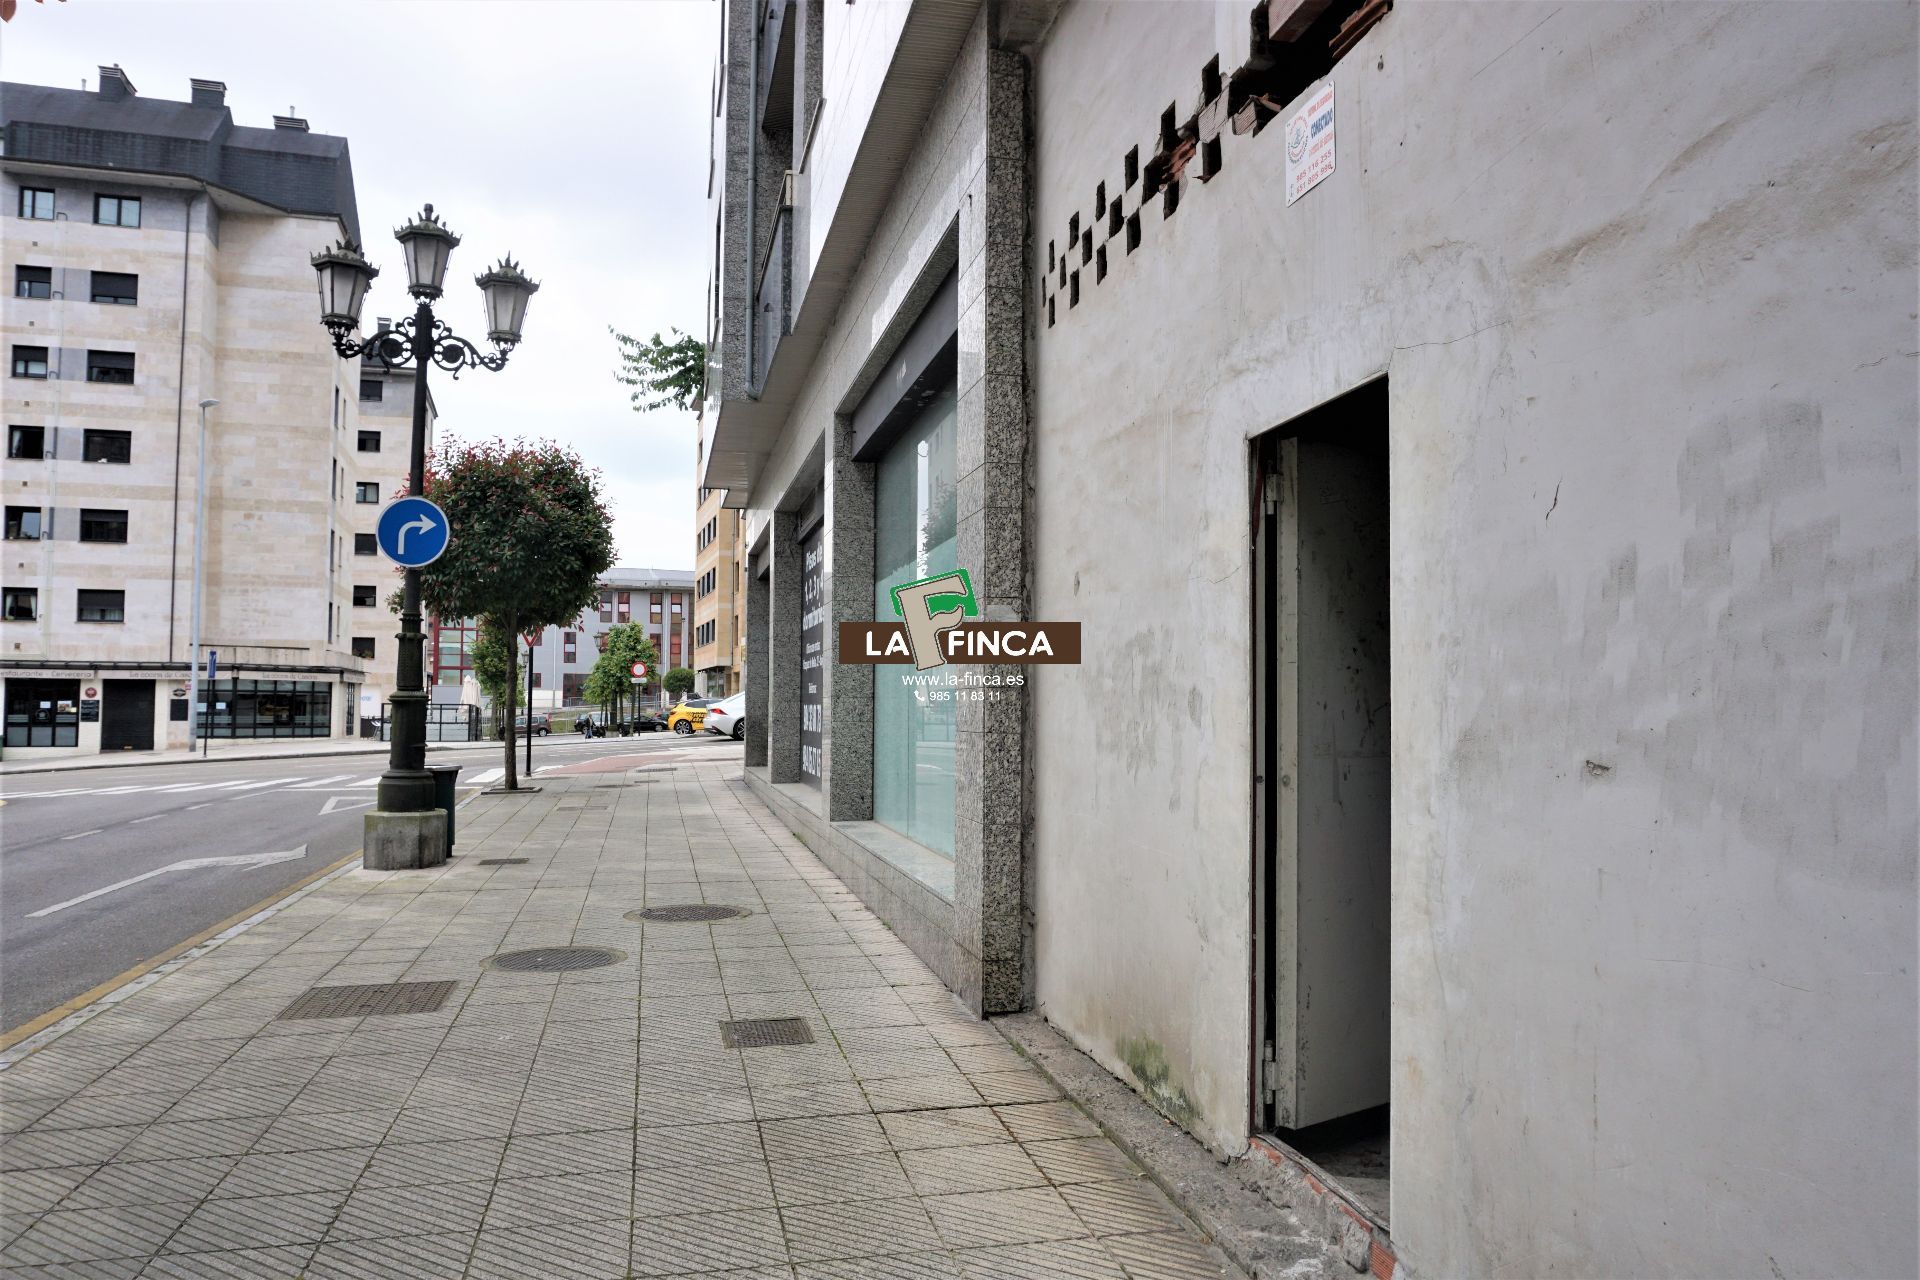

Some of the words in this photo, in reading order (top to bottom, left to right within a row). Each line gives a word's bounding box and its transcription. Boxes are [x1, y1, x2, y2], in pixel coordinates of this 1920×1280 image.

[805, 550, 817, 573] Pisos
[817, 541, 823, 563] de
[0, 669, 44, 677] estaurante
